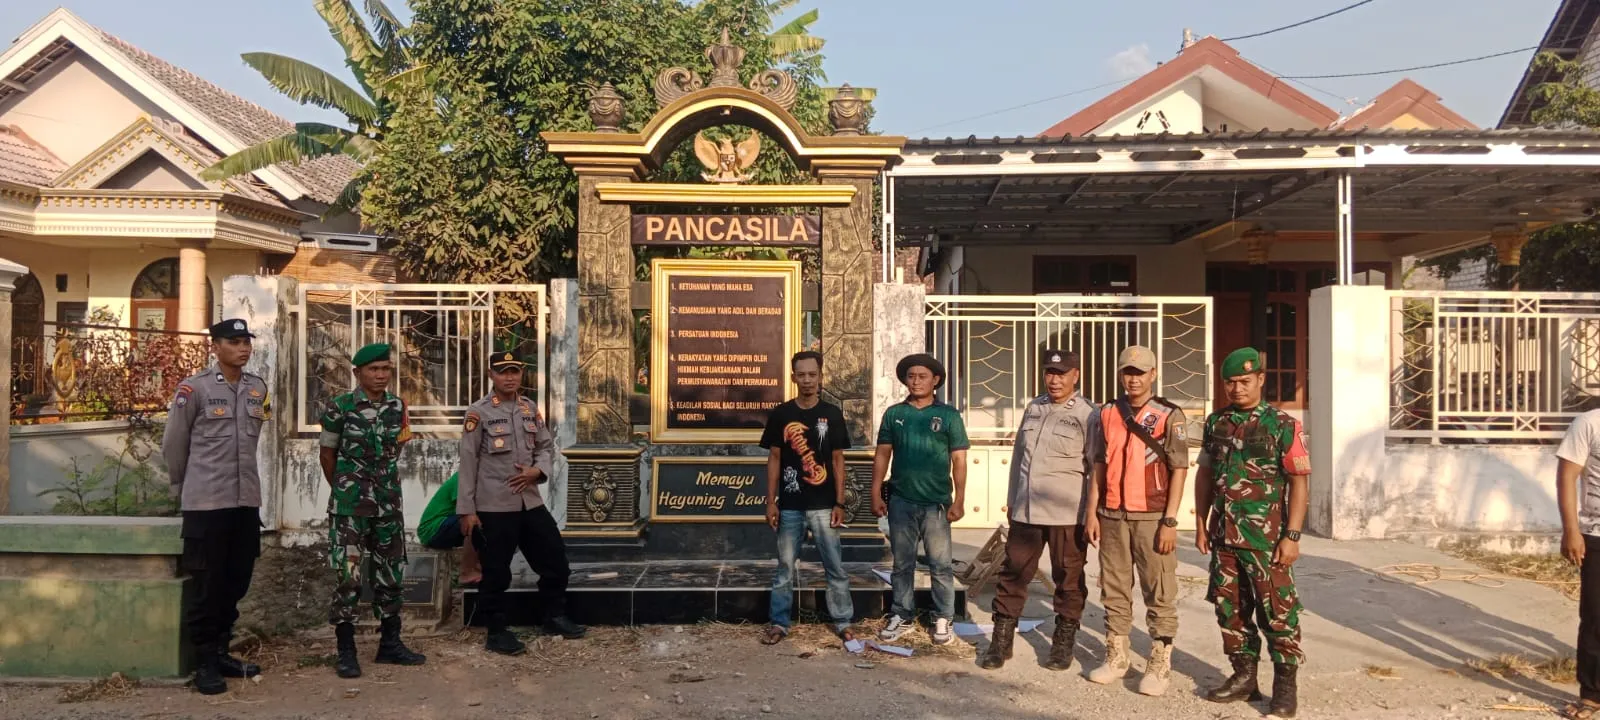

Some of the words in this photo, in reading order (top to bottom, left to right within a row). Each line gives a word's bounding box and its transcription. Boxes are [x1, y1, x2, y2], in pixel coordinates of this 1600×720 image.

[646, 216, 809, 241] PANCASILA
[679, 283, 710, 291] KETUHANAN
[711, 283, 726, 291] YANG
[726, 283, 742, 291] MAHA
[743, 283, 753, 291] ESA
[678, 306, 717, 315] KEMANUSIAAN
[717, 307, 732, 315] YANG
[732, 307, 744, 315] ADIL
[746, 307, 757, 315] DAN
[757, 307, 781, 315] BERADAB
[678, 330, 709, 338] PERSATUAN
[709, 330, 739, 338] INDONESIA
[678, 354, 712, 362] KERAKYATAN
[712, 354, 728, 362] YANG
[728, 354, 753, 362] DIPIMPIN
[753, 354, 767, 362] OLEH
[742, 366, 761, 374] DALAM
[732, 378, 744, 386] DAN
[744, 378, 778, 386] PERWAKILAN
[676, 401, 702, 409] KEADILAN
[736, 402, 760, 410] SELURUH
[677, 413, 706, 421] INDONESIA
[1060, 419, 1078, 428] POLRI
[696, 471, 755, 490] Memayu
[659, 492, 726, 510] Hayuning
